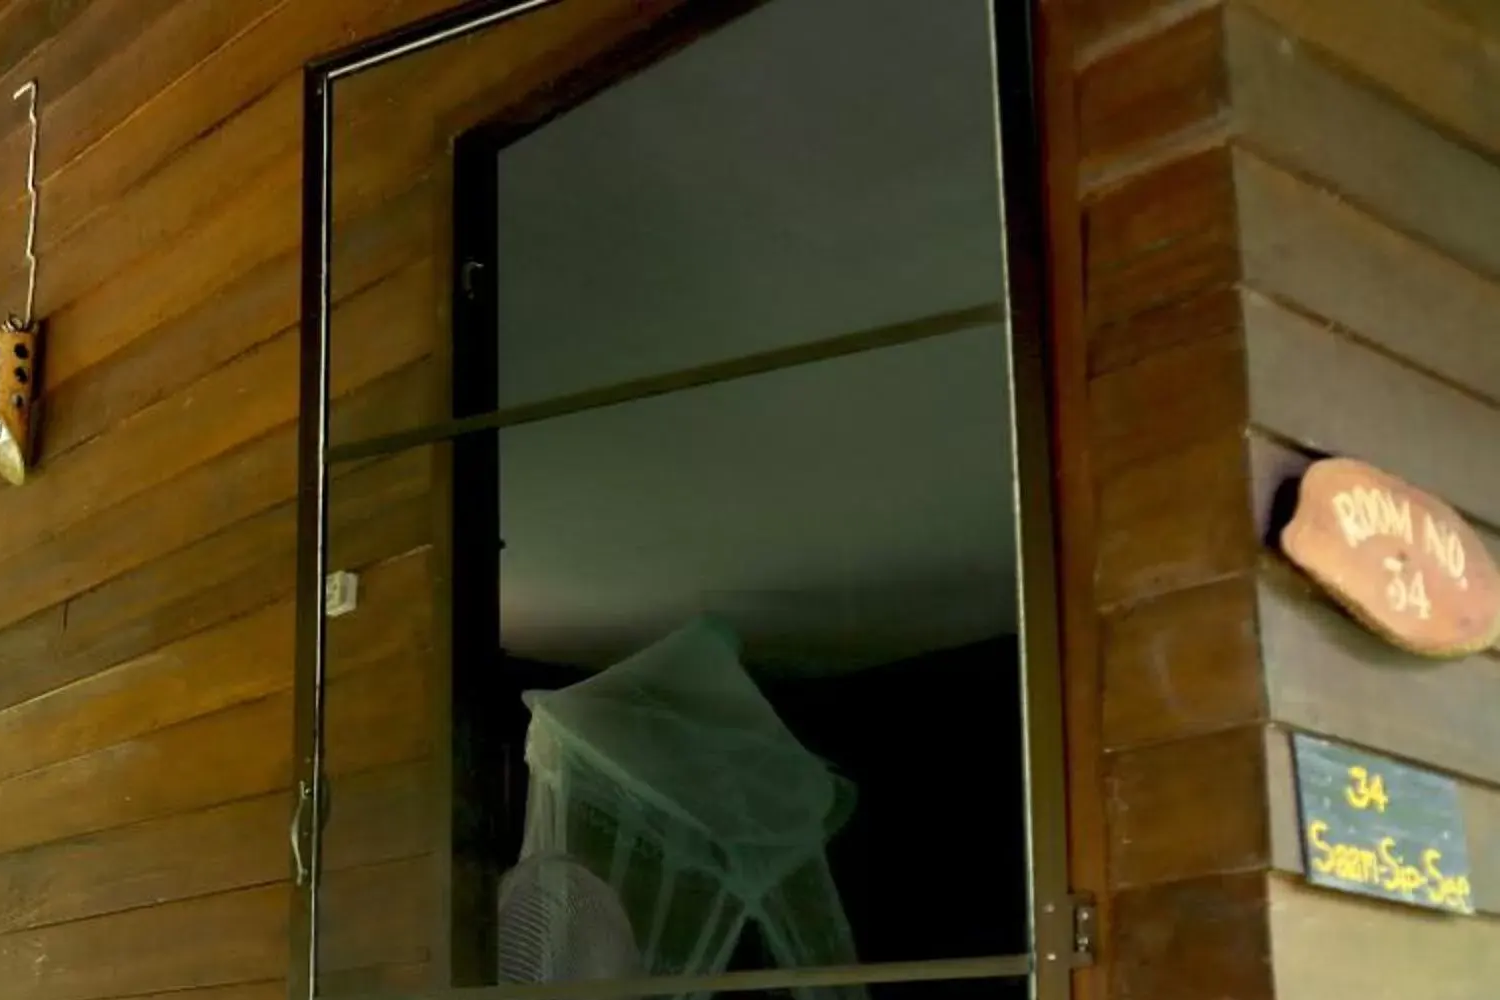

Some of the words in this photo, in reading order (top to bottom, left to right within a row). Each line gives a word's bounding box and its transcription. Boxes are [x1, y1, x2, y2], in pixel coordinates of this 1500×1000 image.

[1332, 483, 1414, 549] ROOM
[1382, 556, 1432, 620] 34
[1345, 765, 1388, 813] 34
